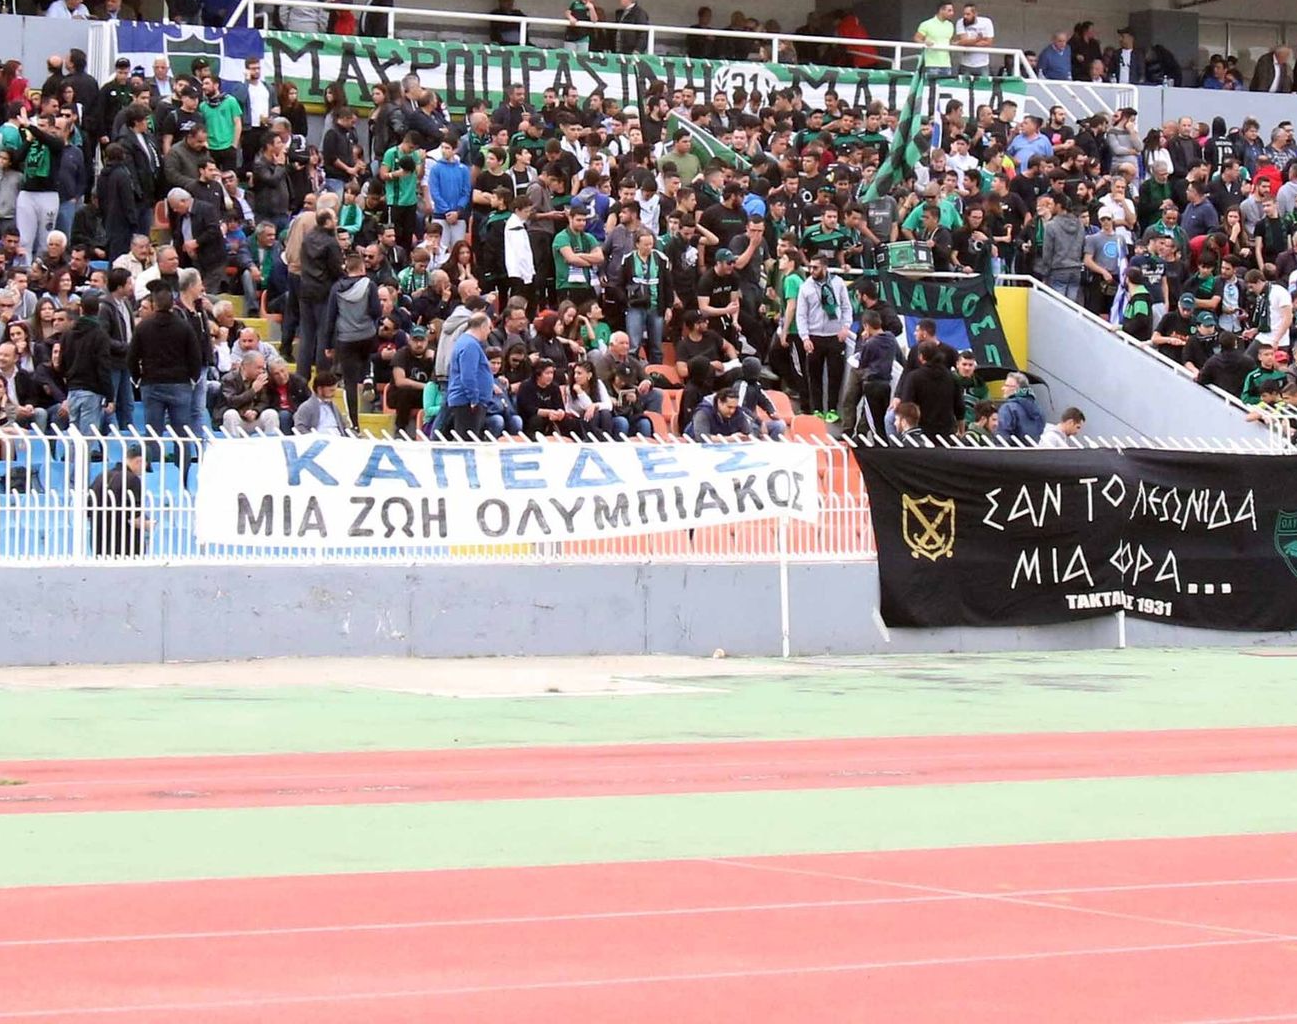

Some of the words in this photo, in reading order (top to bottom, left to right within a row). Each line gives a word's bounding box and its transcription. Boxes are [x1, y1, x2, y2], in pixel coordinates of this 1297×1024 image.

[281, 439, 770, 489] ΚΑΠΕΔΕΣ
[236, 493, 327, 537] ΜΙΑ
[348, 496, 447, 538] ΖΩΗ
[476, 469, 808, 537] ΟΛΥΜΠΙΑΚΟΣ
[982, 482, 1062, 531] ΣΑΝ
[1079, 473, 1126, 522] ΤΟ
[1129, 479, 1258, 532] ΛΕΩΝΙΔΑ
[1011, 546, 1094, 589] ΜΙΑ
[1136, 597, 1172, 616] 1931
